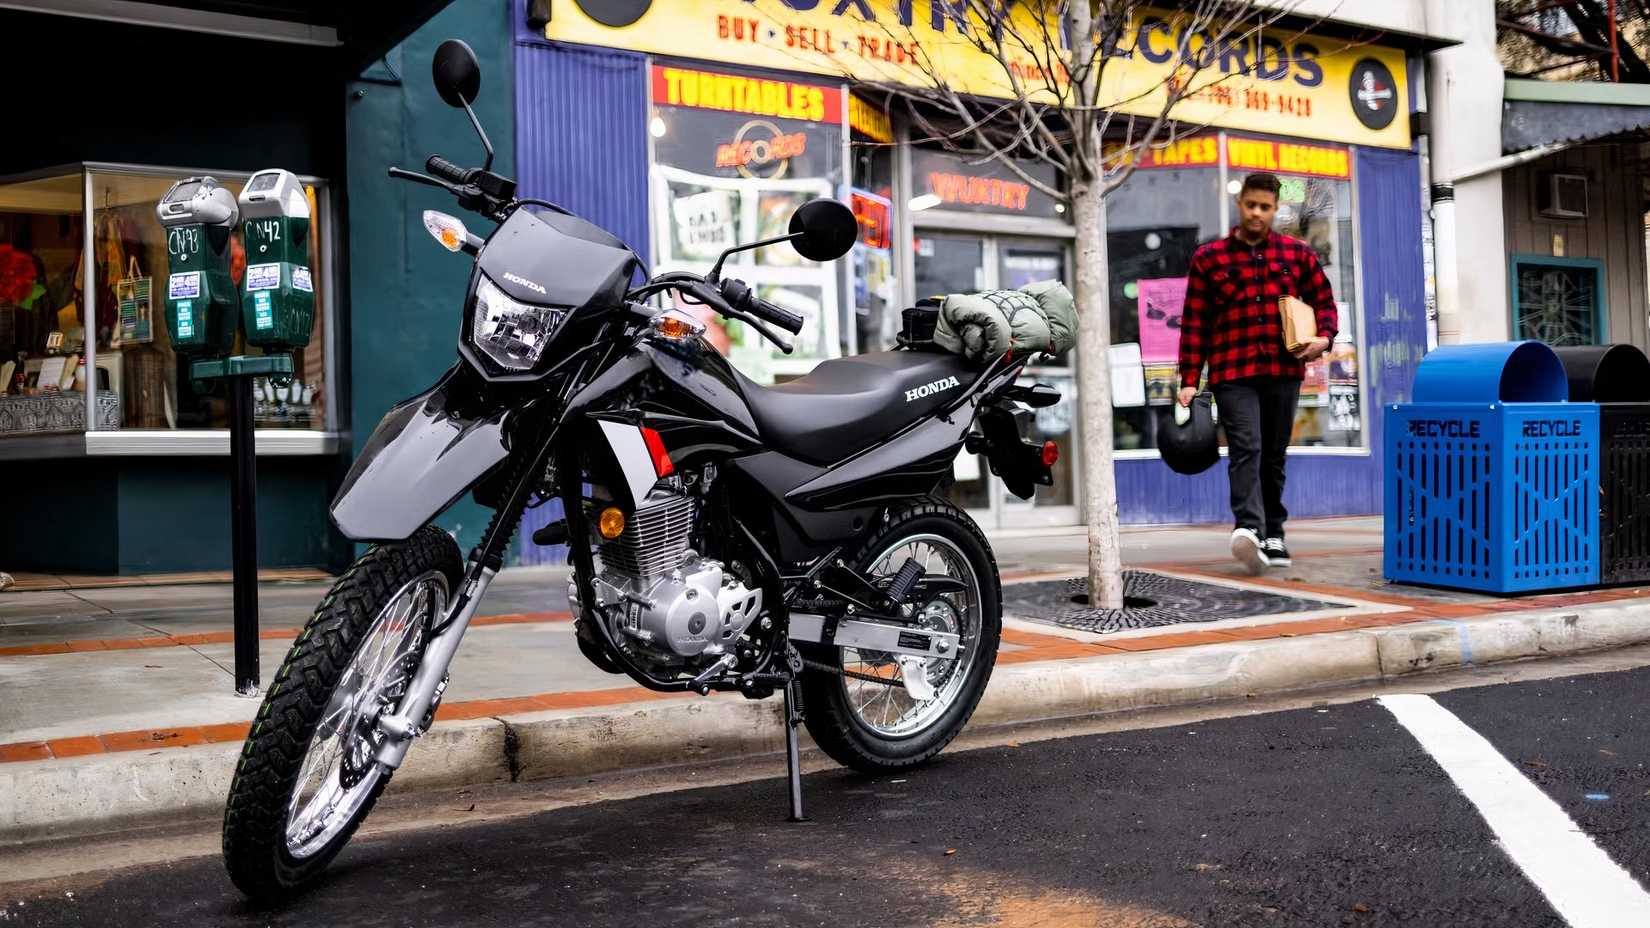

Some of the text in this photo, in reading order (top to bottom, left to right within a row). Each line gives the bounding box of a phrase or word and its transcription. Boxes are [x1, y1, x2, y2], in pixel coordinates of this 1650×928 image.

[717, 14, 759, 43] BUY
[784, 24, 836, 54] SELL
[1062, 12, 1324, 88] ECORDS
[664, 68, 824, 121] TURNTABLES
[1150, 137, 1218, 166] TAPES
[1227, 137, 1277, 170] VINYL
[503, 272, 547, 294] HONDA
[904, 375, 961, 402] HONDA
[1408, 419, 1480, 438] RECYCLE
[1522, 419, 1581, 437] RECYCLE
